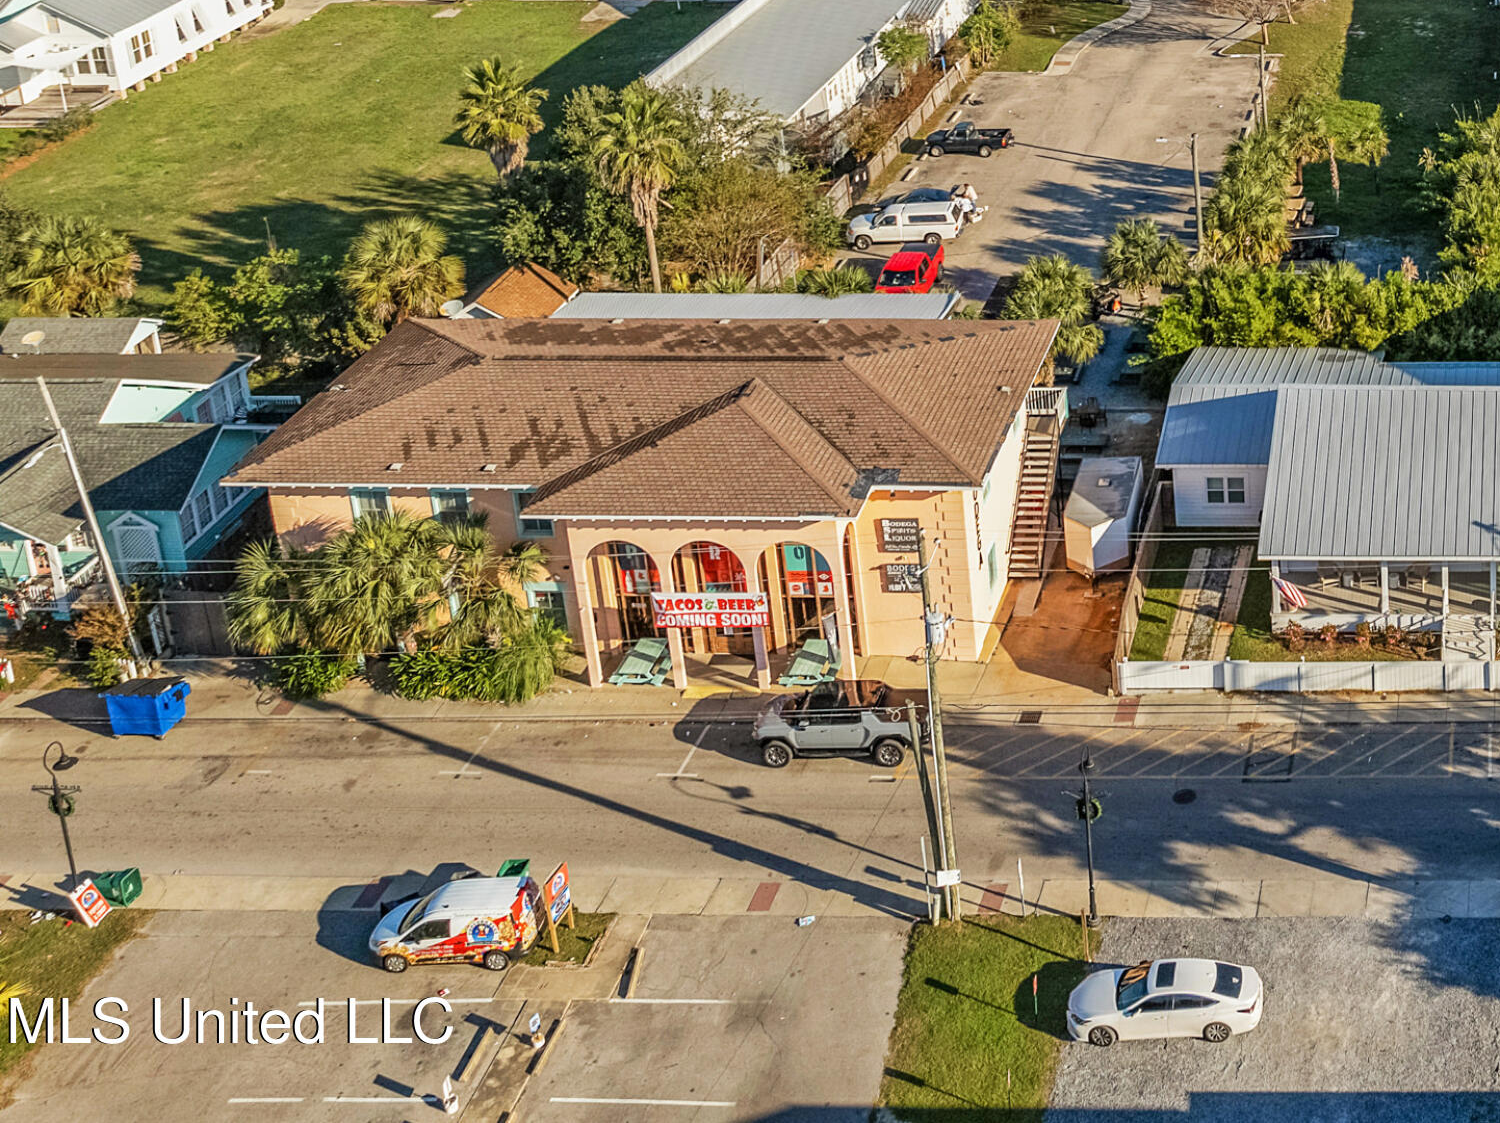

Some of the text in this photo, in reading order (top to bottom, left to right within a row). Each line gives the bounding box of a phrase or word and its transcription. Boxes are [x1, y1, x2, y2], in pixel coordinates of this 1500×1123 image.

[881, 519, 918, 527] BODEGA
[883, 534, 918, 542] LIQUOR
[655, 598, 756, 611] TACOS & BEER
[656, 613, 769, 627] COMING SOON!
